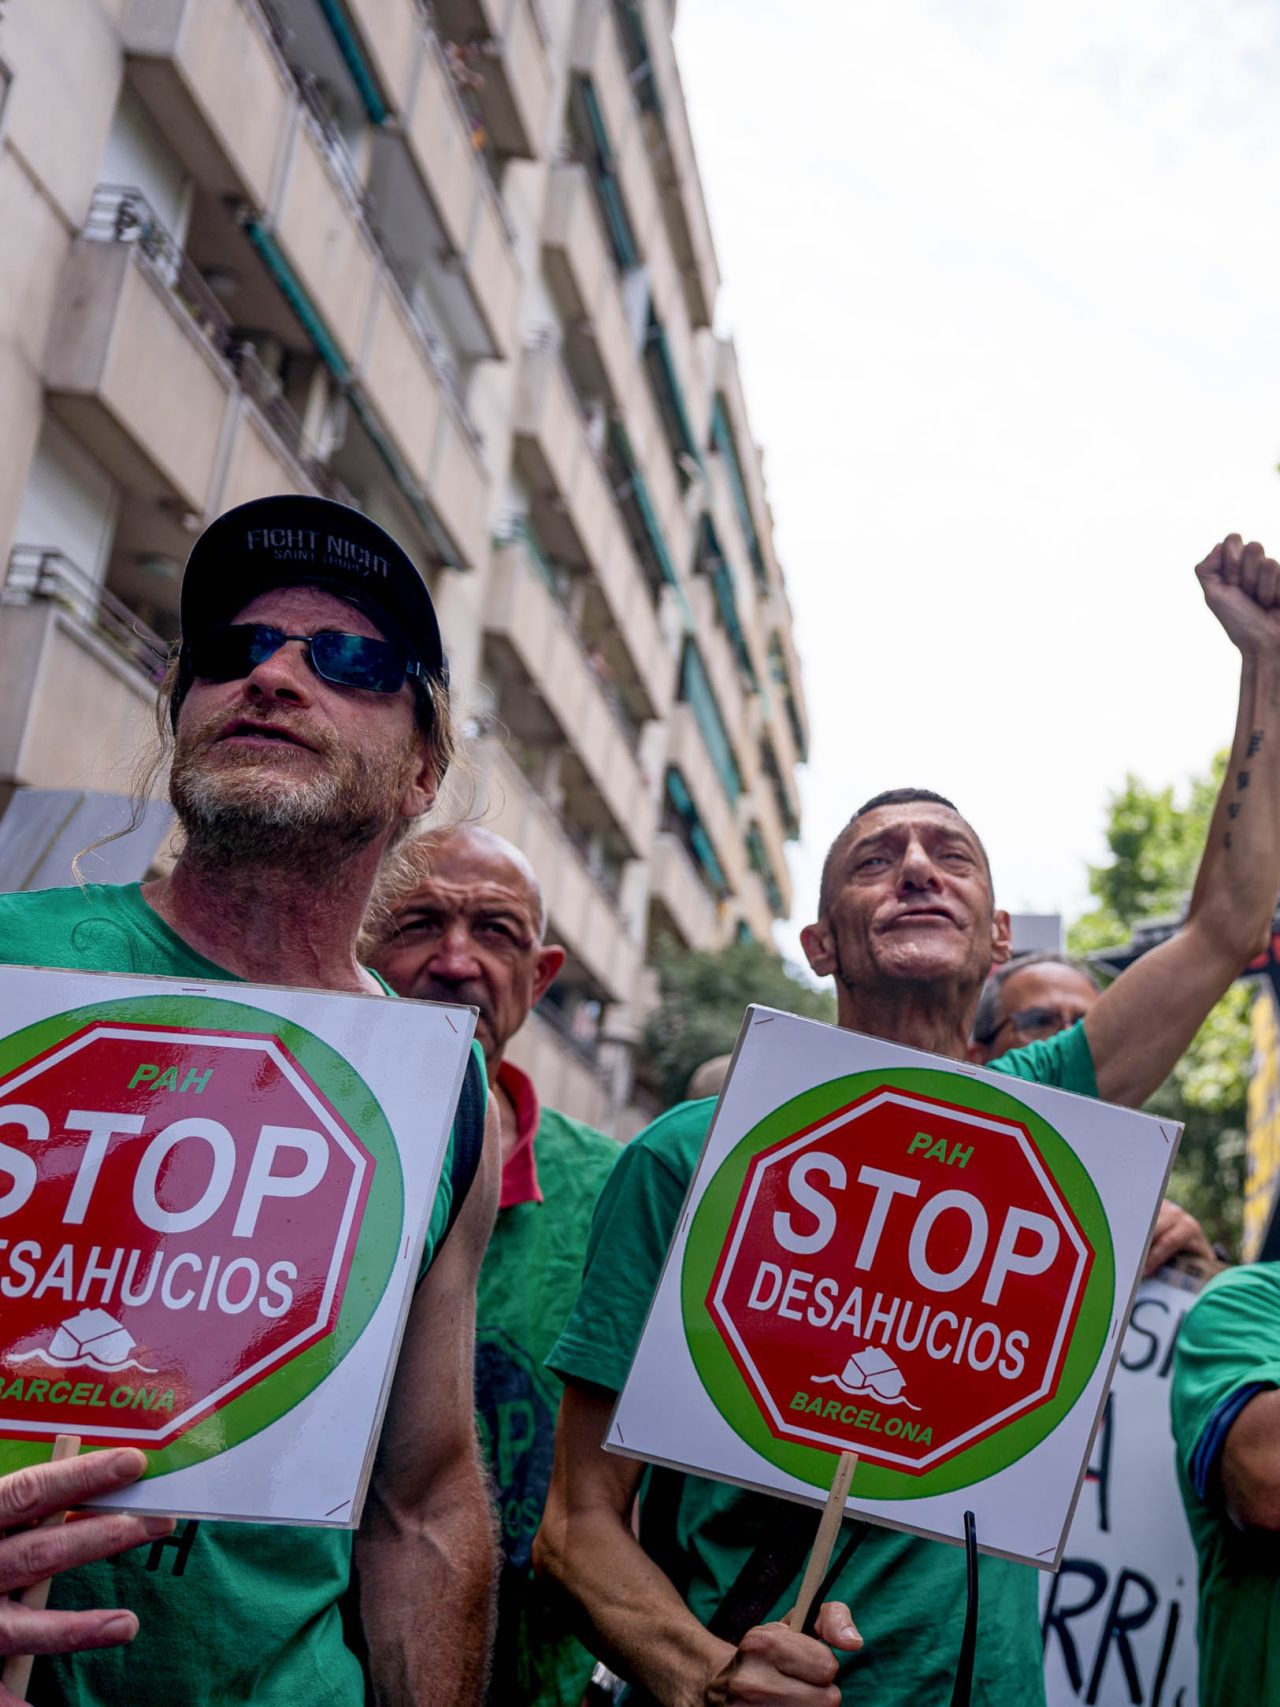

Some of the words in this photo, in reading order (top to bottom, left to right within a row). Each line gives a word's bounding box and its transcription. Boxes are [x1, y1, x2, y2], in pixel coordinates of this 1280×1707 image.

[273, 549, 316, 562] SAINT
[128, 1063, 214, 1094] PAH
[0, 1104, 330, 1238] STOP
[907, 1132, 975, 1169] PAH
[772, 1151, 1060, 1305] STOP
[0, 1238, 298, 1318] SAHUCIOS
[747, 1261, 1030, 1380] DESAHUCIOS
[789, 1391, 933, 1446] BARCELONA
